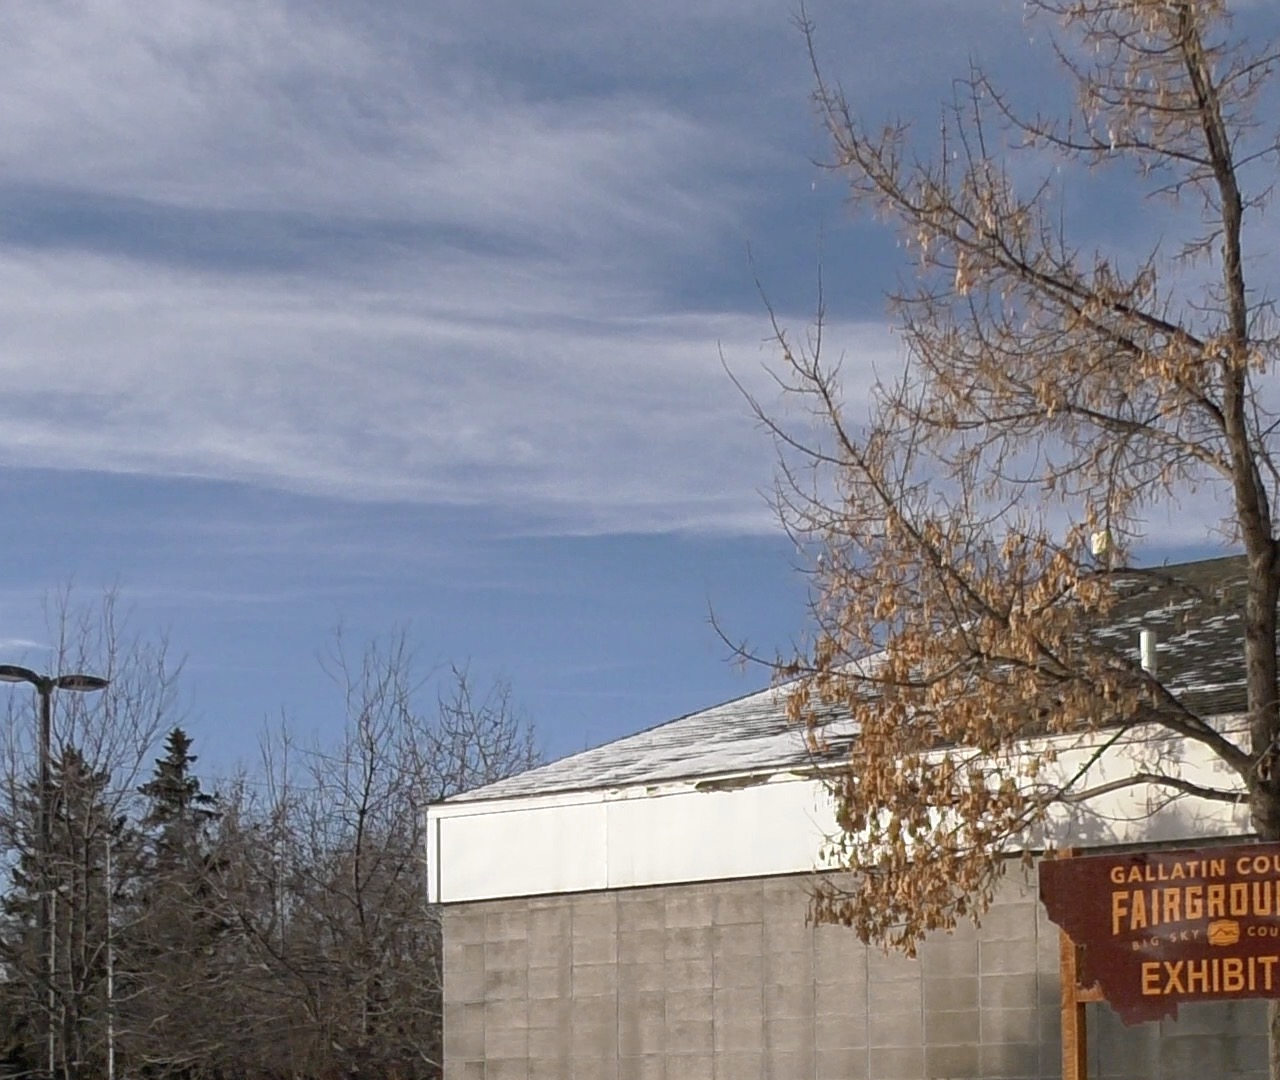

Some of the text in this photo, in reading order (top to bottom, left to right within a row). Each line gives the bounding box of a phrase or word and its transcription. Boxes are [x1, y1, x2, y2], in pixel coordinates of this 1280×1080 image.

[1110, 859, 1225, 883] GALLATIN
[1132, 936, 1159, 951] BIG
[1170, 929, 1200, 943] SKY
[1141, 955, 1278, 995] EXHIBIT
